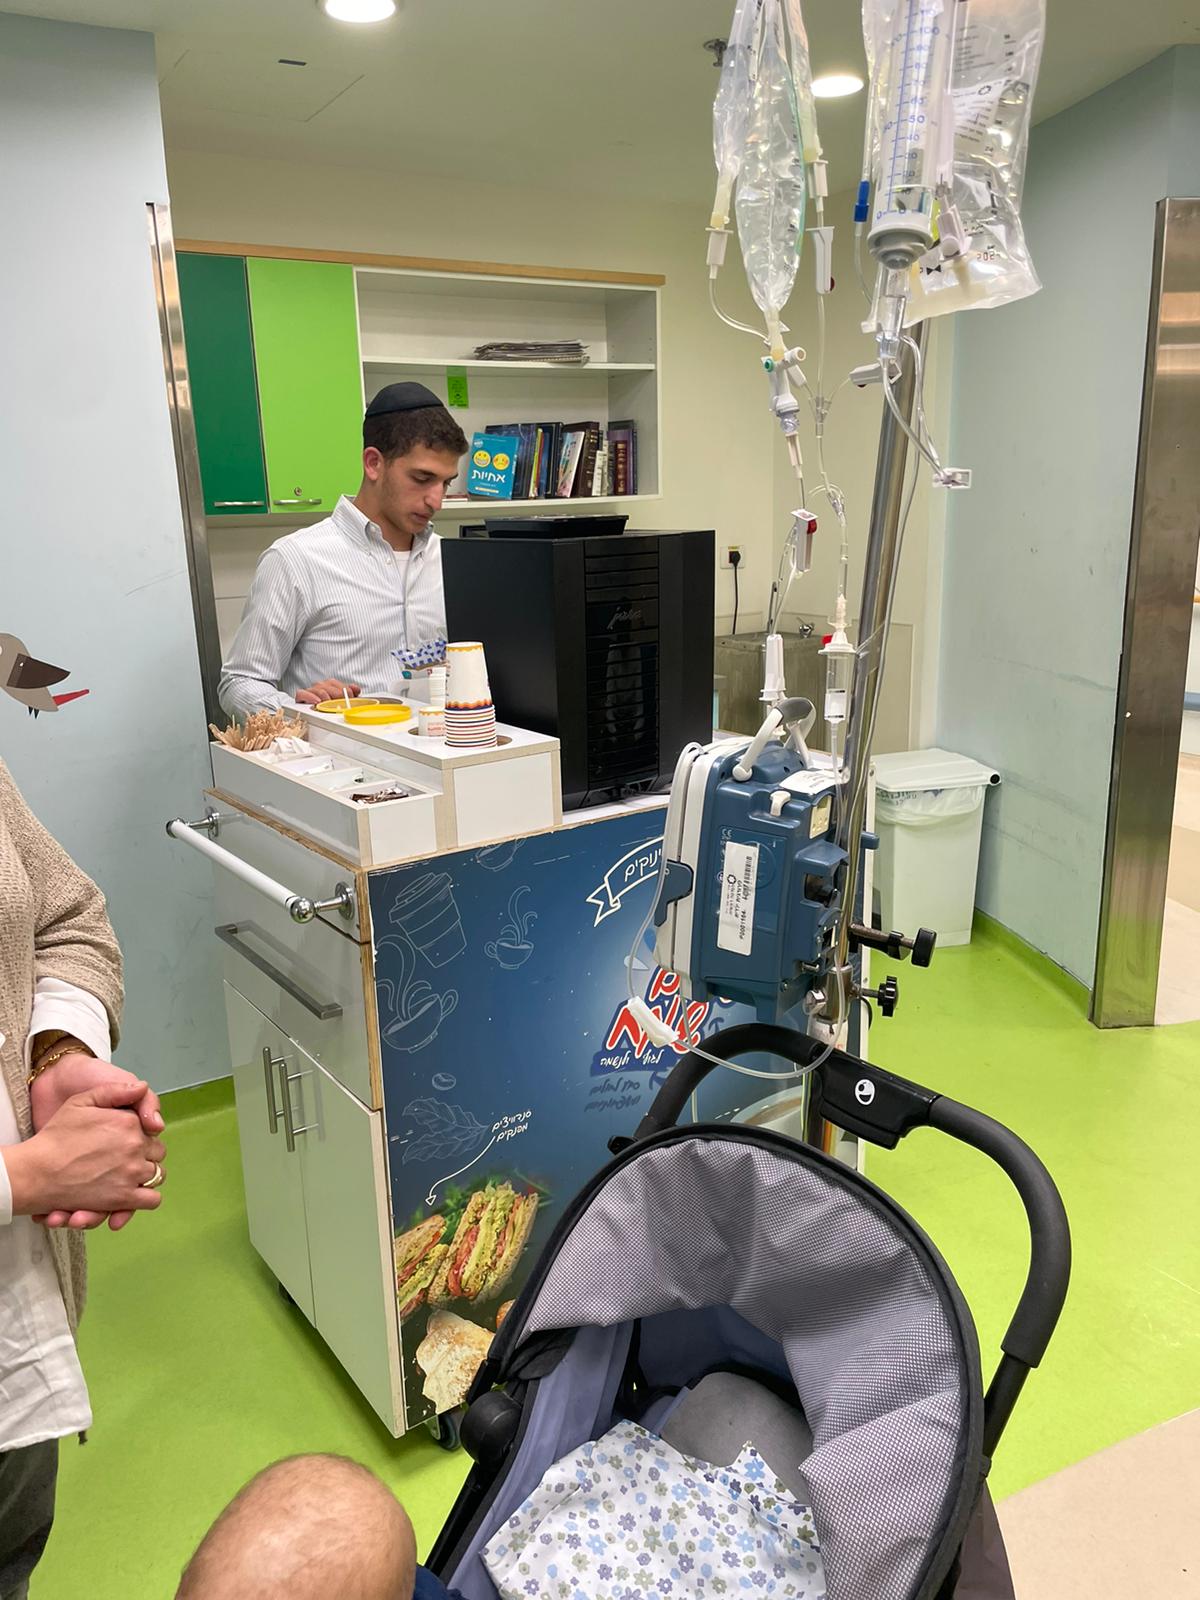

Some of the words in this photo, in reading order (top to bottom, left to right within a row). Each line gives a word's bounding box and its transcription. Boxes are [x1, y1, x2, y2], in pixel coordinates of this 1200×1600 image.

[471, 469, 506, 483] אחיות
[624, 848, 663, 882] ינוקים
[600, 1050, 632, 1069] ולנשמה
[643, 1049, 664, 1065] לגוף
[496, 1122, 528, 1143] מפנקים
